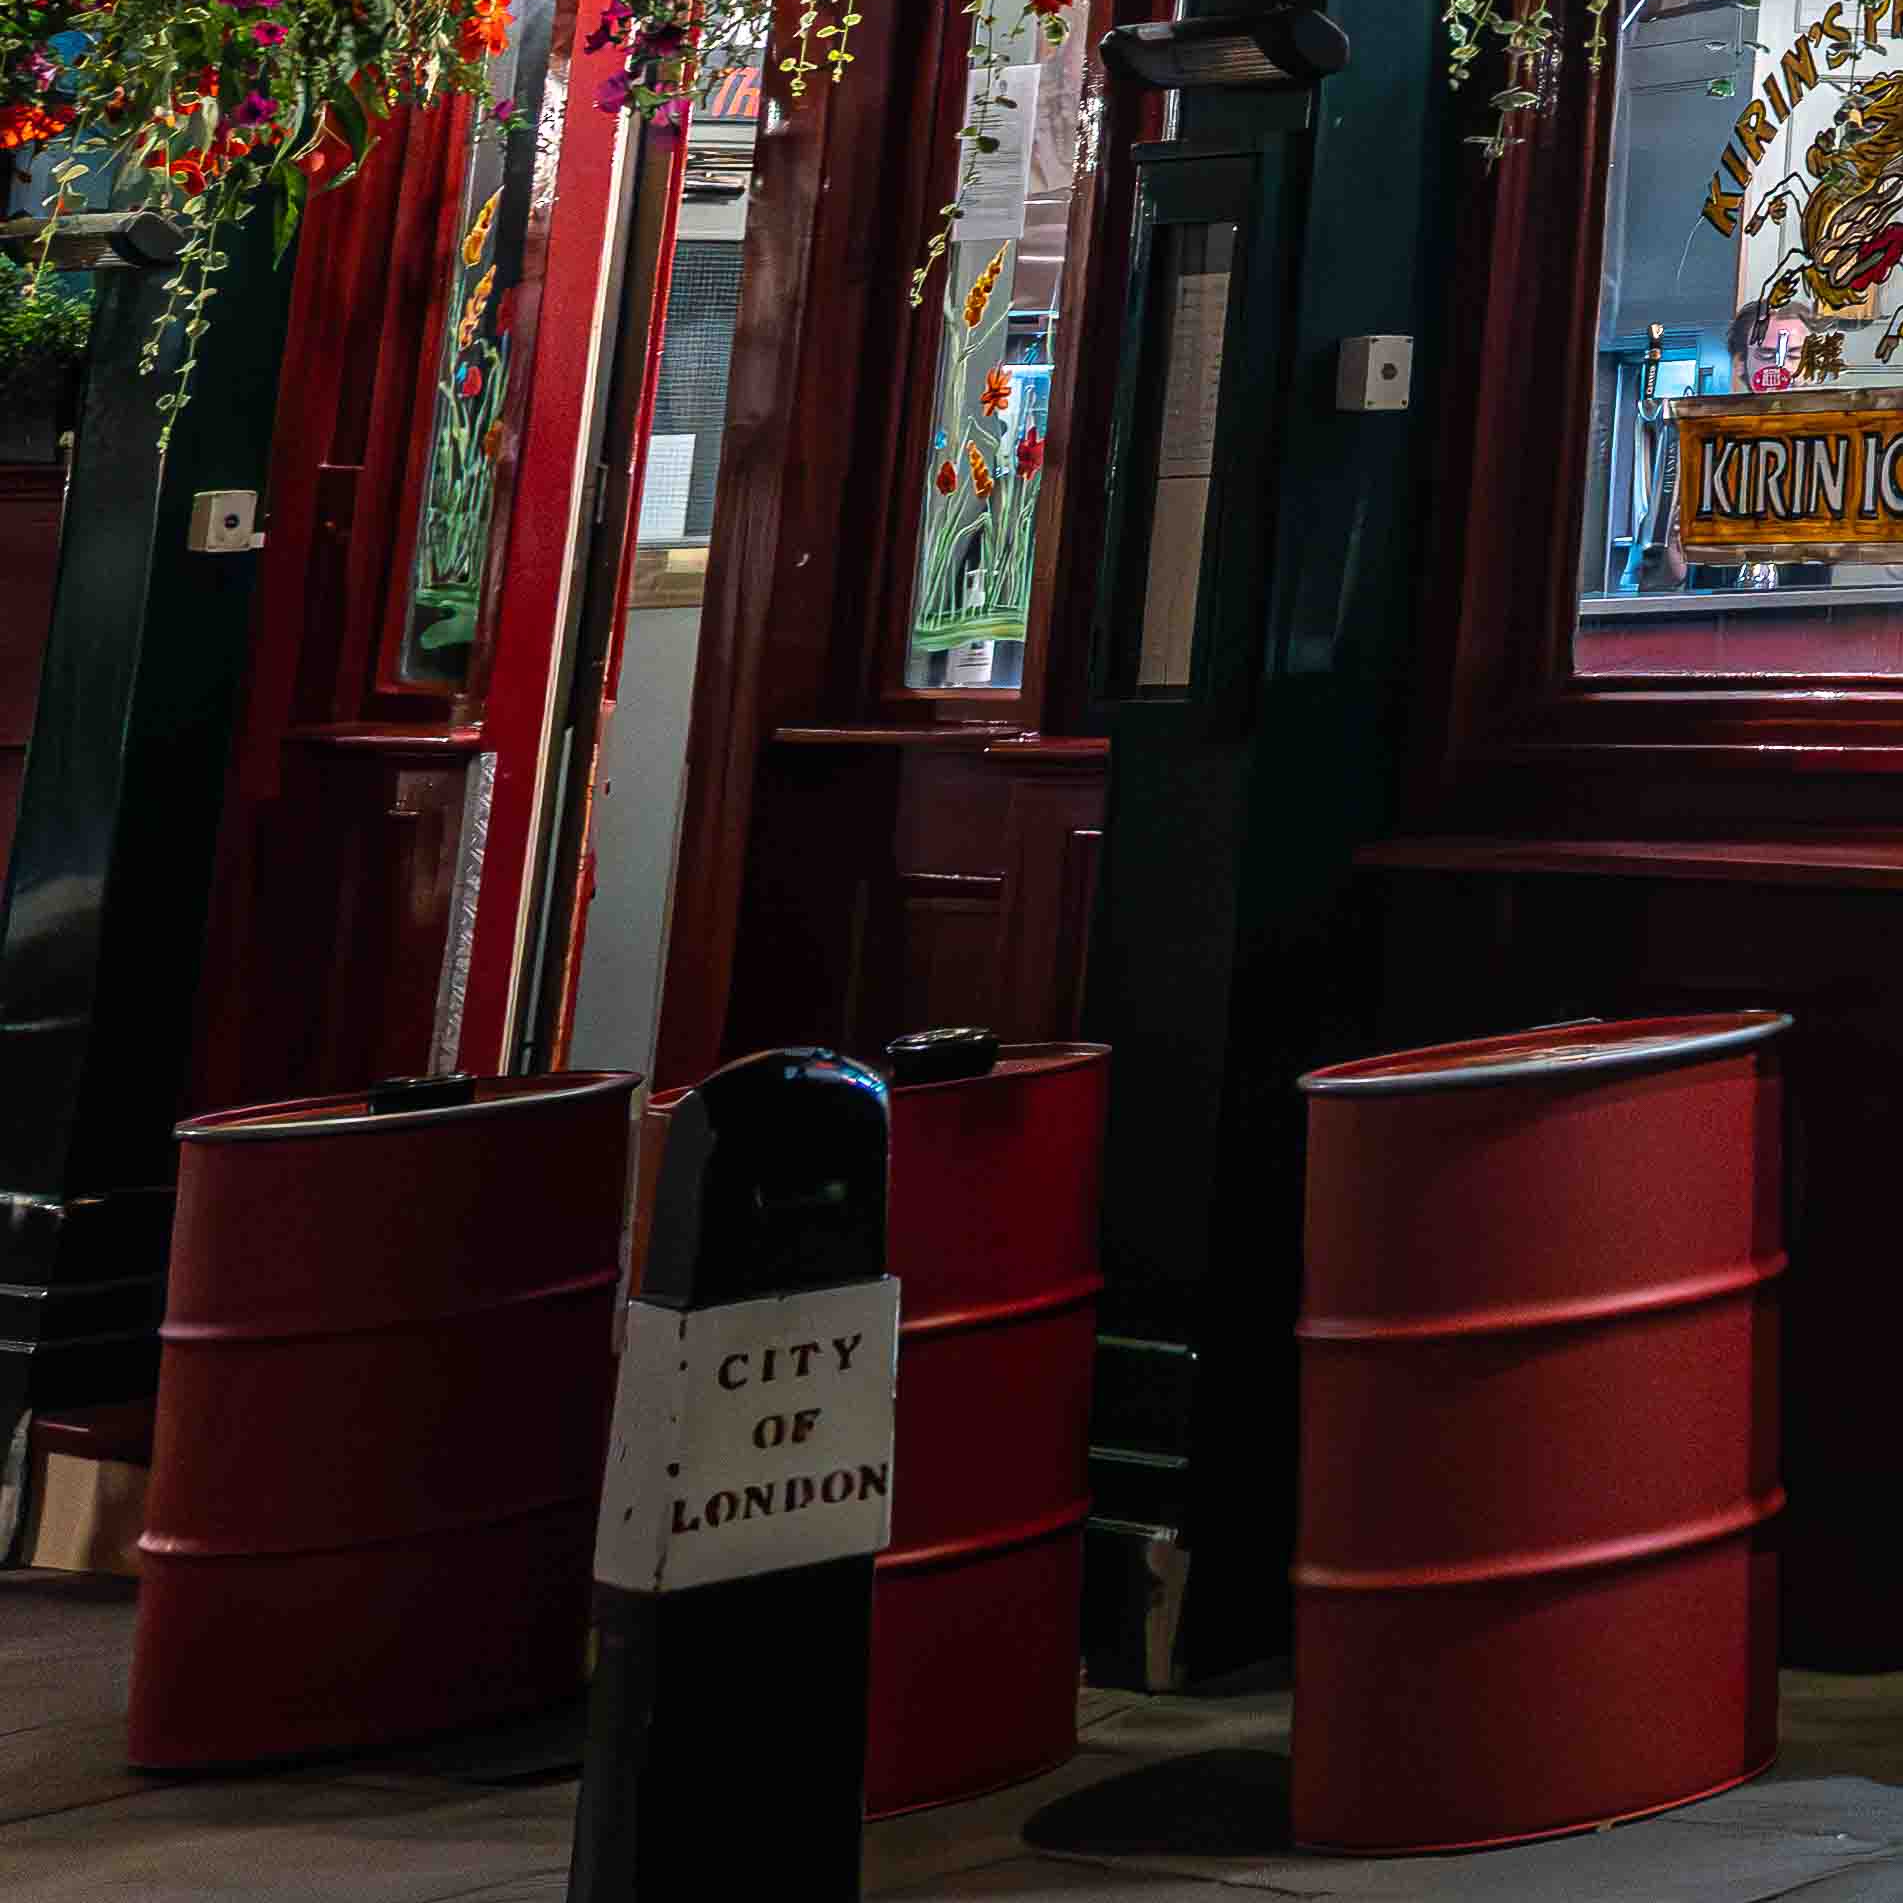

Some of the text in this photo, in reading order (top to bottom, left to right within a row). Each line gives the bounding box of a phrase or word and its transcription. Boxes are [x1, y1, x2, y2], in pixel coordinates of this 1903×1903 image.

[1701, 1, 1852, 239] KIRIN'S
[1701, 437, 1849, 516] KIRIN
[716, 1333, 863, 1391] CITY
[753, 1407, 822, 1449] OF
[671, 1461, 889, 1535] LONDON
